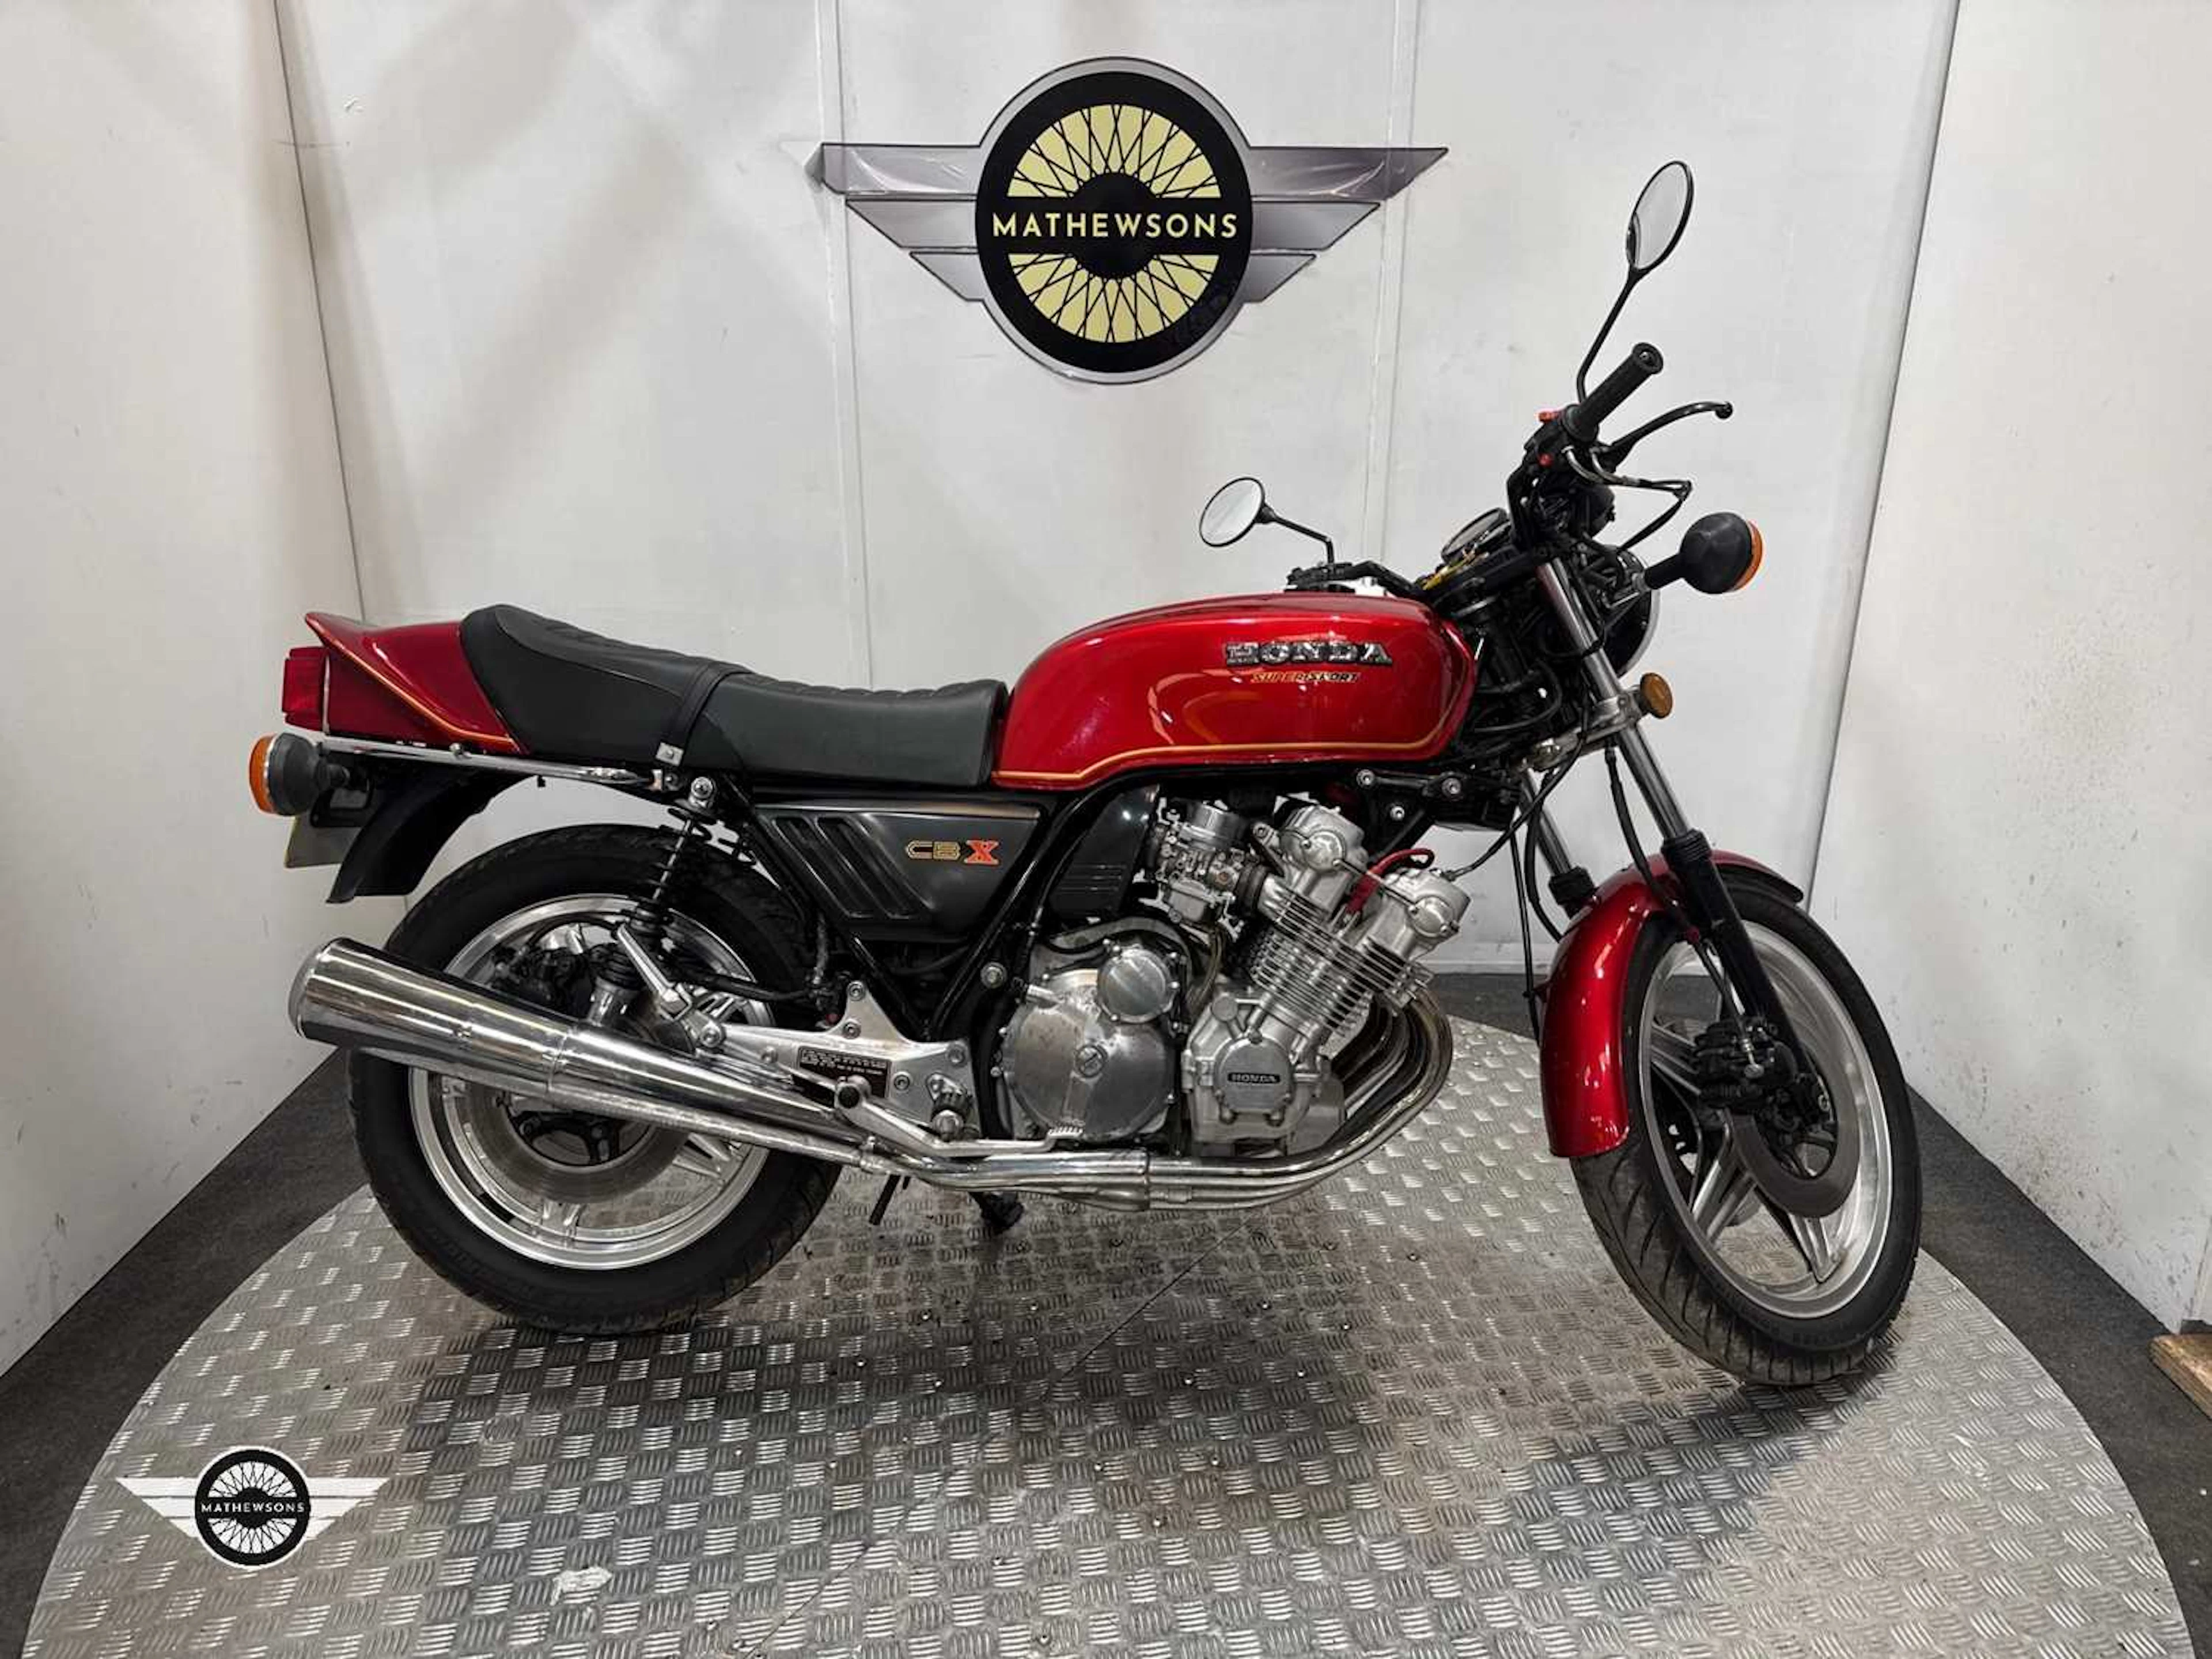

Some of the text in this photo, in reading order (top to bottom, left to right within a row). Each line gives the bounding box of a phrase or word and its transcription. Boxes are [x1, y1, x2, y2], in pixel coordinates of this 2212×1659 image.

[992, 212, 1238, 238] MATHEWSONS
[1226, 642, 1393, 666] HONDA
[905, 839, 1000, 864] CBX
